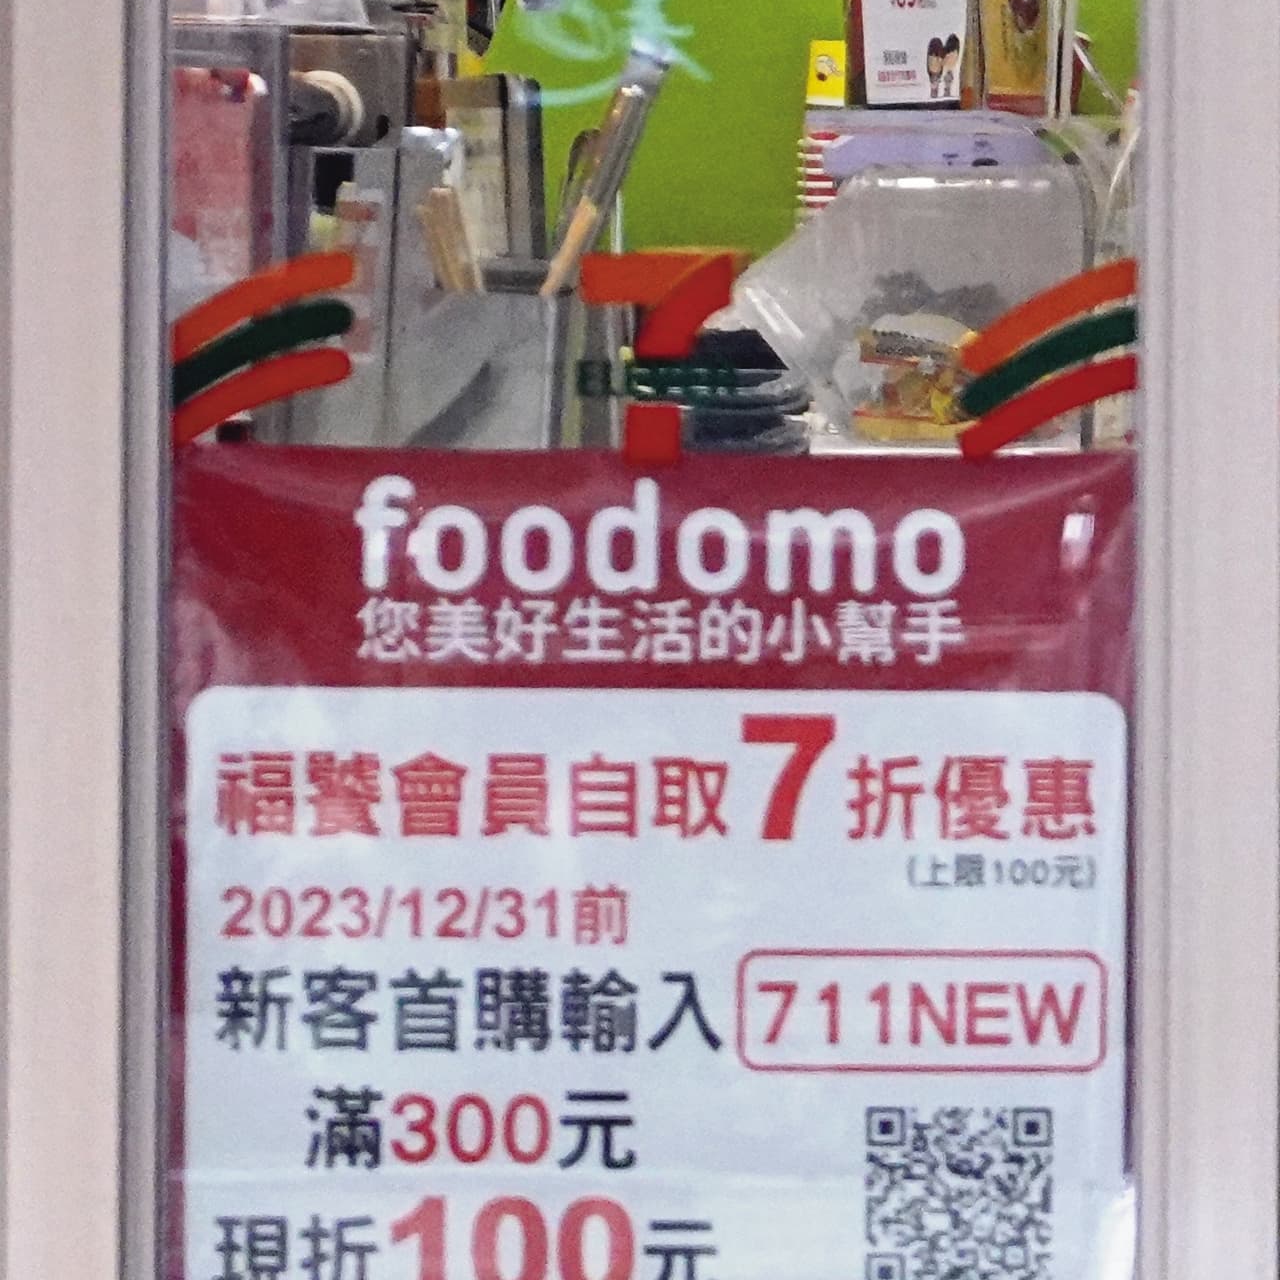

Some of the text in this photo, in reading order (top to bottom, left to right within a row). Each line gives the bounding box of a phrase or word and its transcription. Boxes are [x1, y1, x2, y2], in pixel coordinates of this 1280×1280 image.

[354, 474, 967, 596] foodomo
[356, 600, 965, 667] 您美好生活的小幫手
[218, 884, 630, 944] 2023/12/31前
[215, 967, 1087, 1053] 新客首購輸入 711NEW
[304, 1086, 638, 1170] 滿300元
[213, 1195, 718, 1280] 現折100元
